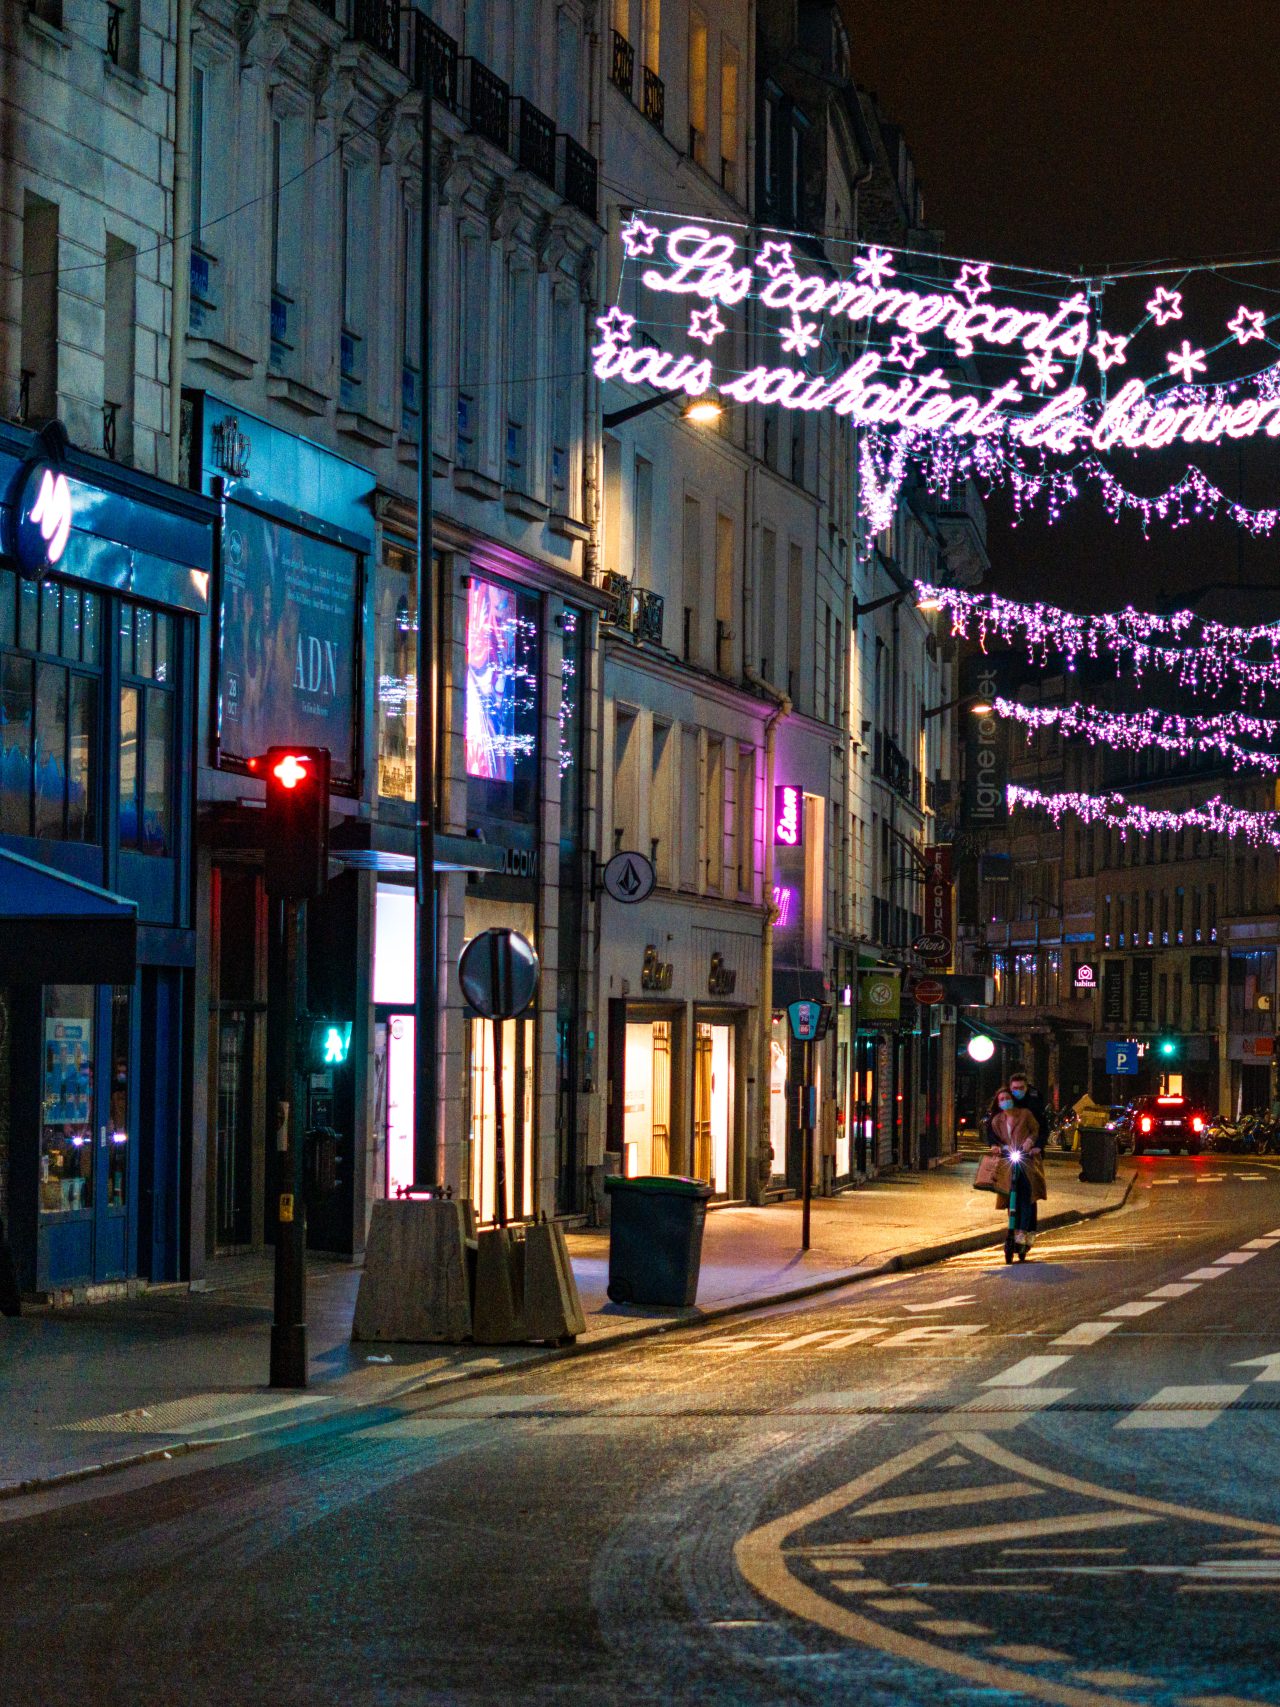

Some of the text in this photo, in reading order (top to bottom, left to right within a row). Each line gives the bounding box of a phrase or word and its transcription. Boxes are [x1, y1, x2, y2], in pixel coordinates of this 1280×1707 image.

[642, 226, 1091, 357] Les commerçants
[592, 339, 712, 397] vous
[719, 352, 1024, 436] souhaitent
[1009, 384, 1092, 455] la
[292, 632, 338, 696] ADN
[971, 668, 1002, 818] ligne roet
[502, 848, 538, 878] LCOM
[1074, 979, 1097, 988] habitat
[1117, 1053, 1127, 1067] P
